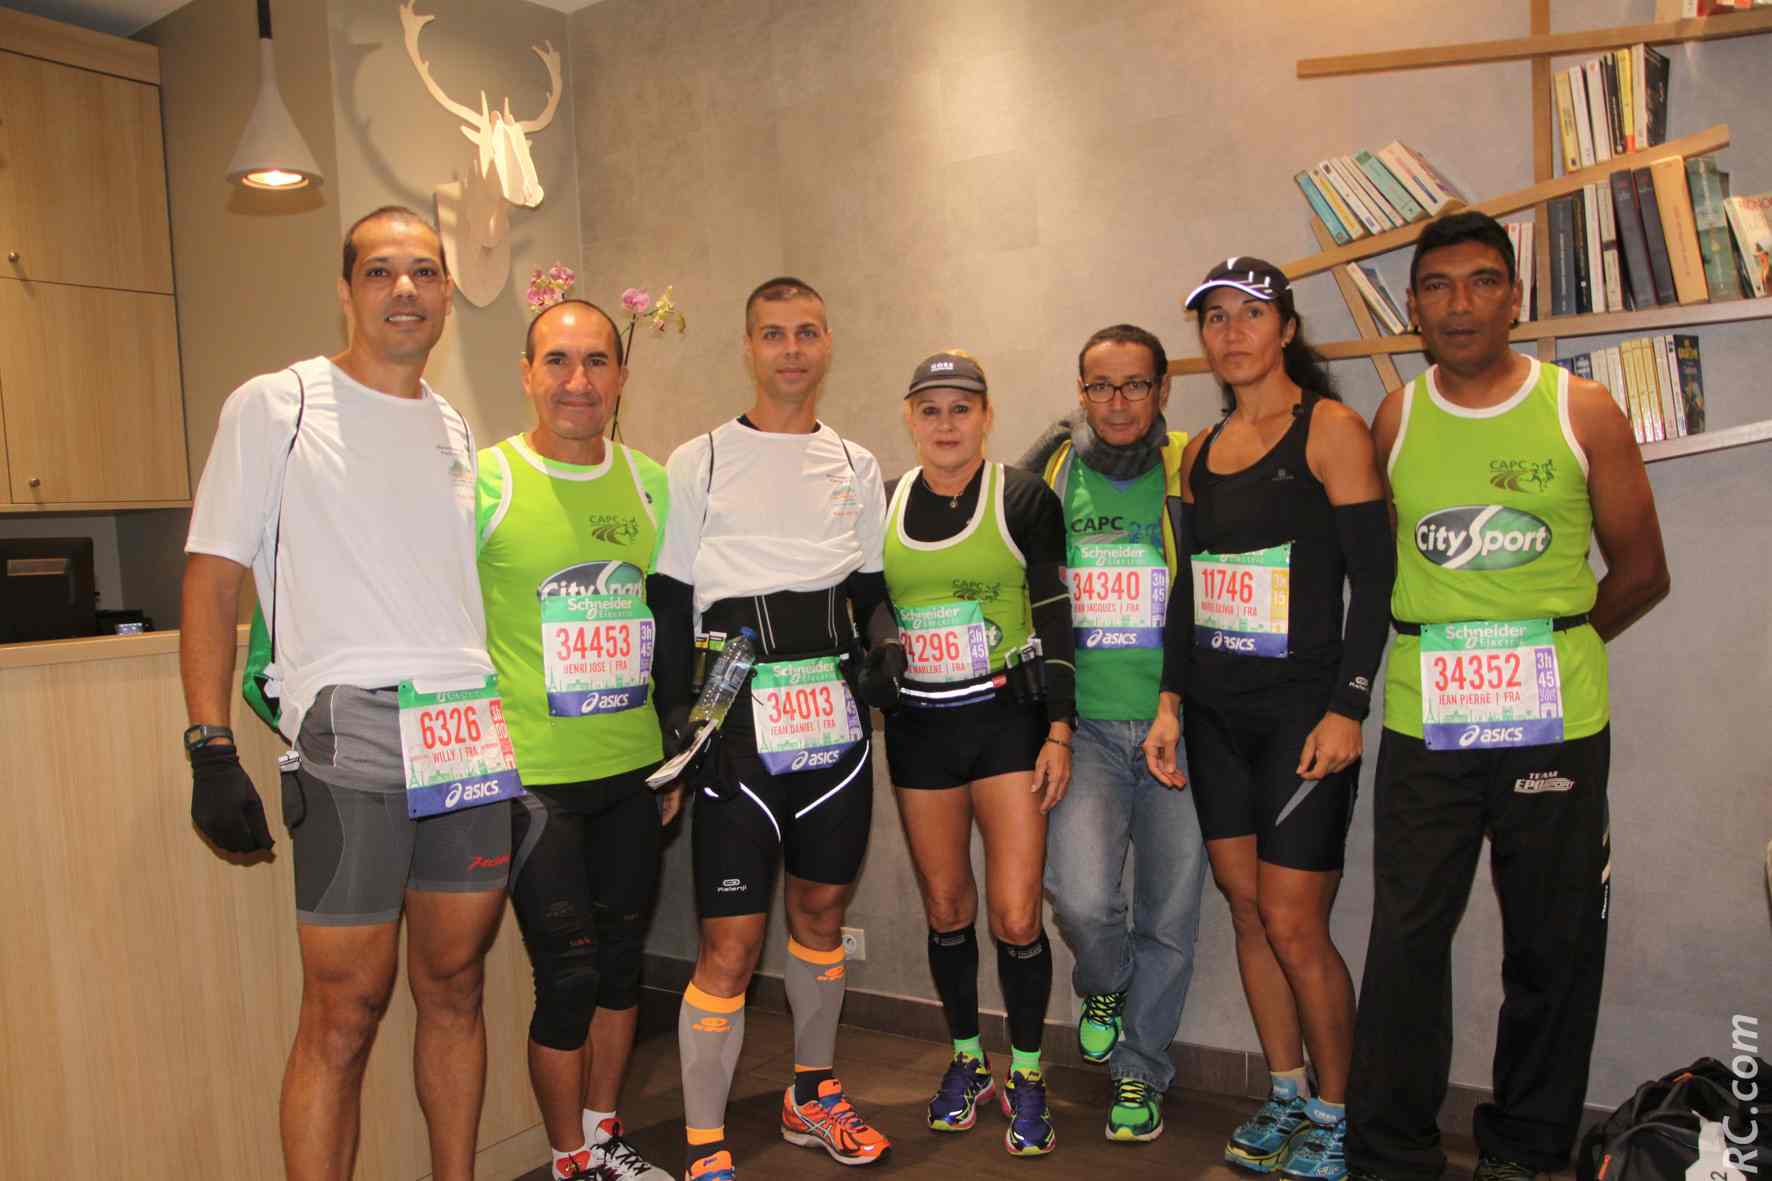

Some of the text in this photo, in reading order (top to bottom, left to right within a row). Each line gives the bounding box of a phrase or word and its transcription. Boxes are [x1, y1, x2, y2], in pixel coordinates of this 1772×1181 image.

[1490, 460, 1527, 471] CAPC
[1071, 516, 1124, 532] CAPC
[1080, 546, 1144, 560] Schneider
[1072, 571, 1140, 601] 34340
[1201, 568, 1253, 604] 11746
[567, 597, 632, 612] Schneider
[900, 607, 960, 620] Schneider
[1102, 632, 1137, 645] asics
[1446, 624, 1527, 640] Schneider
[555, 624, 631, 662] 34453
[616, 660, 628, 671] FRA
[1537, 653, 1553, 669] 3h
[772, 663, 834, 677] Schneider
[1434, 652, 1521, 692] 34352
[1538, 671, 1554, 688] 45
[600, 693, 629, 708] asics
[767, 686, 833, 724] 34013
[1439, 691, 1520, 705] JEAN PIERRE FRA
[420, 705, 481, 749] 6326
[1480, 727, 1523, 743] asics
[432, 750, 456, 765] WILLY
[808, 750, 840, 766] asics
[1529, 771, 1559, 779] TEAM
[463, 780, 499, 800] asics
